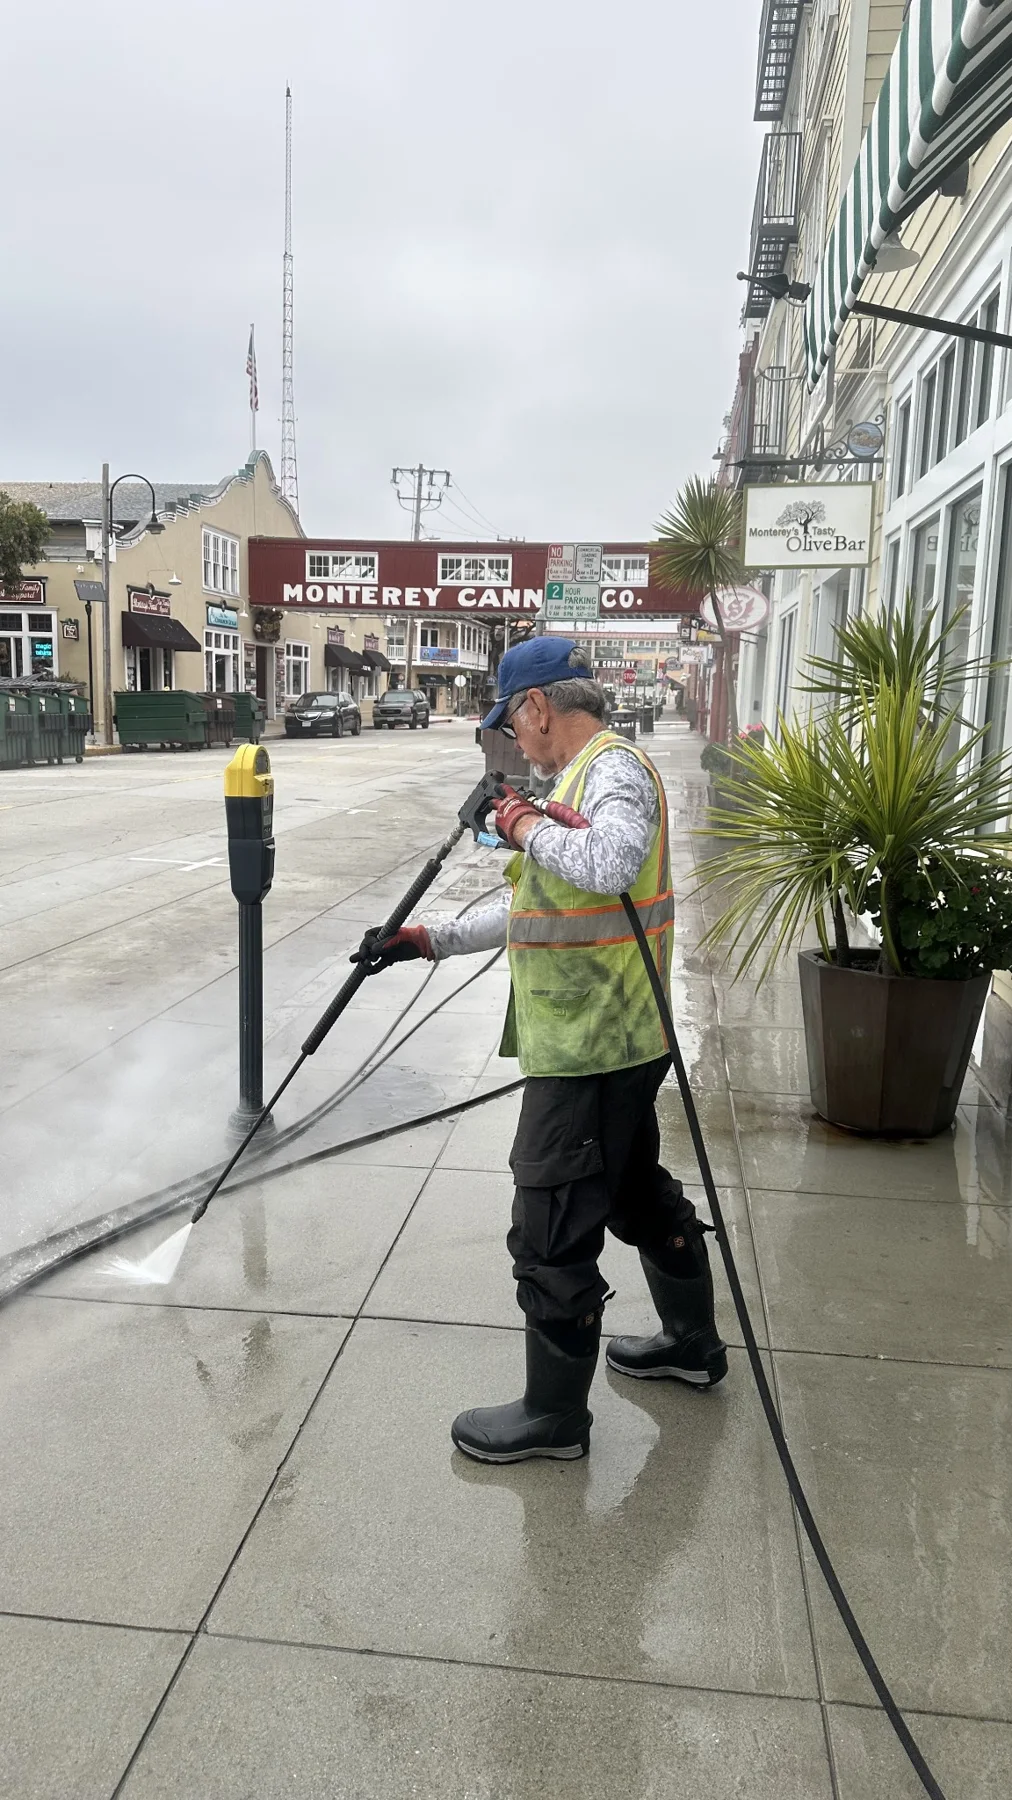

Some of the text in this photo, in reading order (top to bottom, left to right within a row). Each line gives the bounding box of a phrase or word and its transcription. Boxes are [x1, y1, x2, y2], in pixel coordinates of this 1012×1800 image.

[749, 527, 799, 538] Monterey's
[812, 526, 836, 537] Tasty
[786, 535, 866, 552] Olive Bar
[551, 547, 562, 558] NO
[550, 559, 573, 567] PARKING
[283, 583, 643, 608] MONTEREY CANN CO.
[552, 585, 560, 598] 2
[565, 597, 597, 605] PARKING
[602, 660, 635, 668] COMPANY
